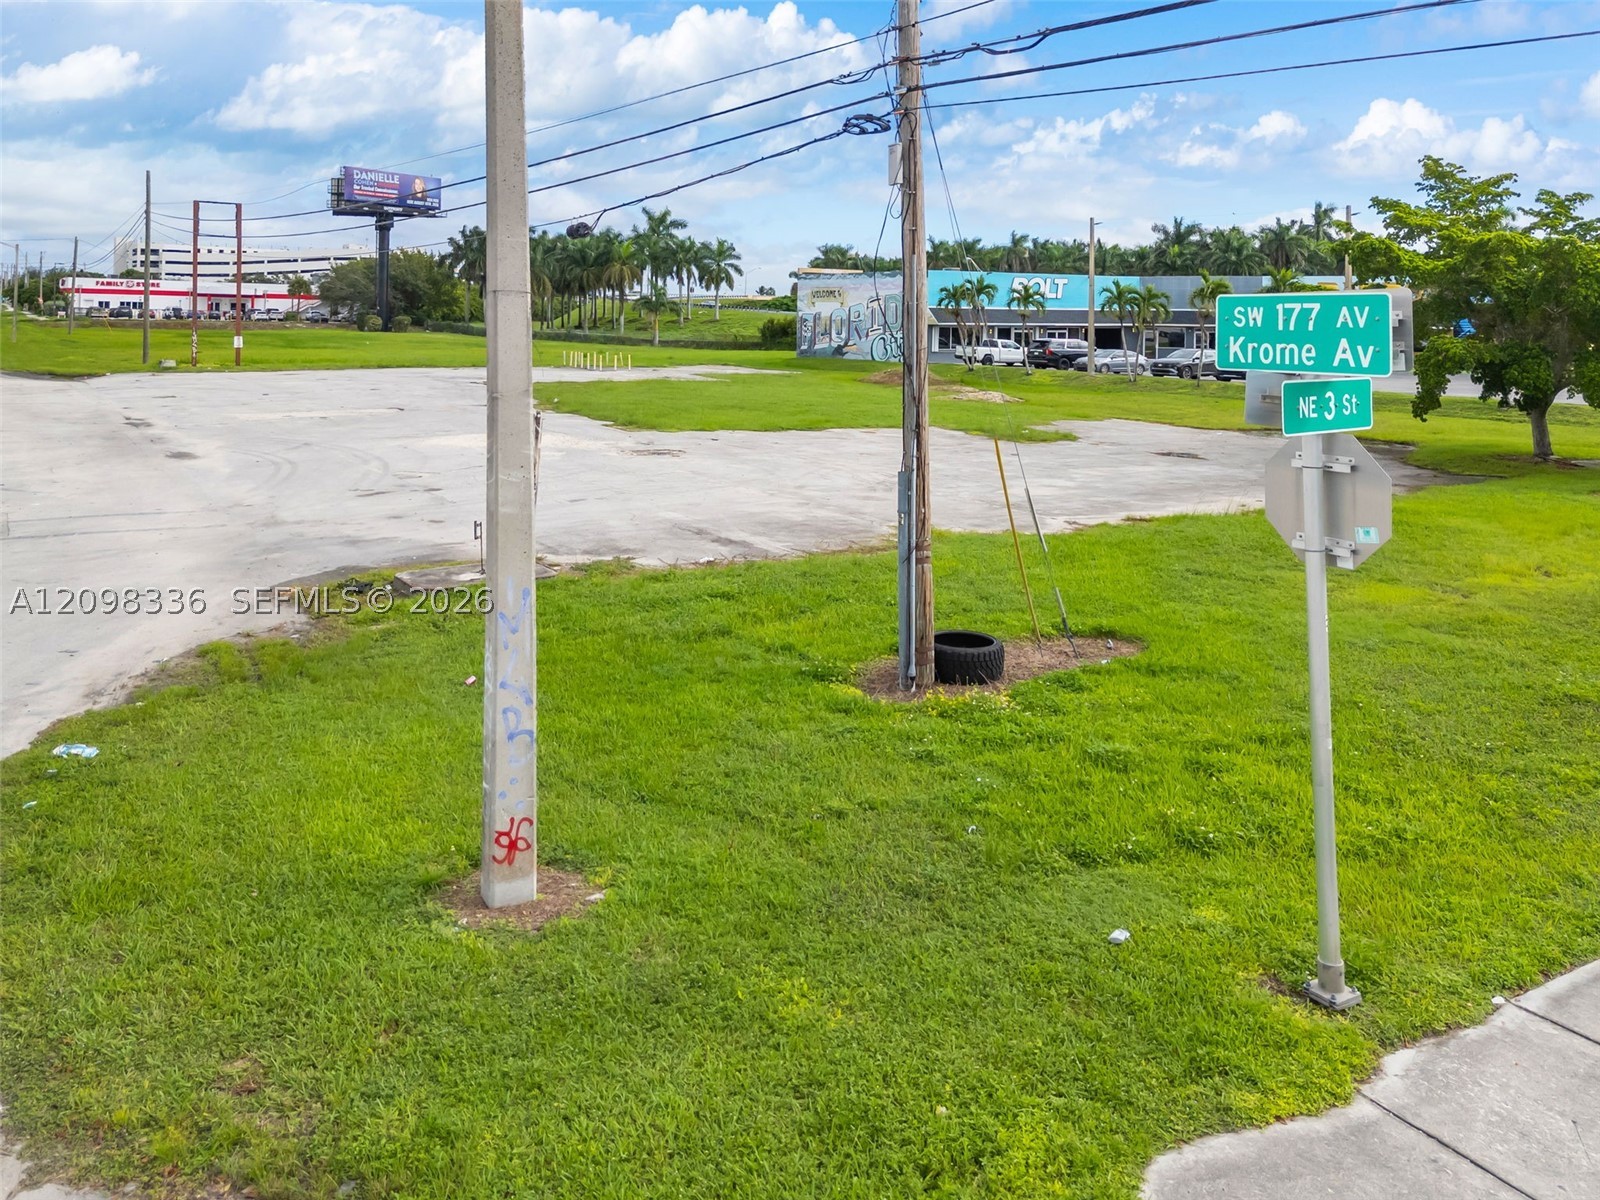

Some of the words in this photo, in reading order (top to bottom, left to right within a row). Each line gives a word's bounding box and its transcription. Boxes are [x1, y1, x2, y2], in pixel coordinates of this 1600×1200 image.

[353, 170, 400, 184] DANIELLE
[811, 290, 836, 298] WELCOME
[1011, 277, 1068, 299] BOLT
[800, 294, 903, 350] FLORID
[1233, 306, 1264, 328] SW
[1276, 303, 1321, 331] 177
[1336, 306, 1369, 329] AV
[1228, 336, 1316, 366] Krome
[1333, 338, 1374, 368] Av
[1299, 396, 1318, 419] NE
[1323, 391, 1336, 421] 3
[1342, 393, 1358, 416] St
